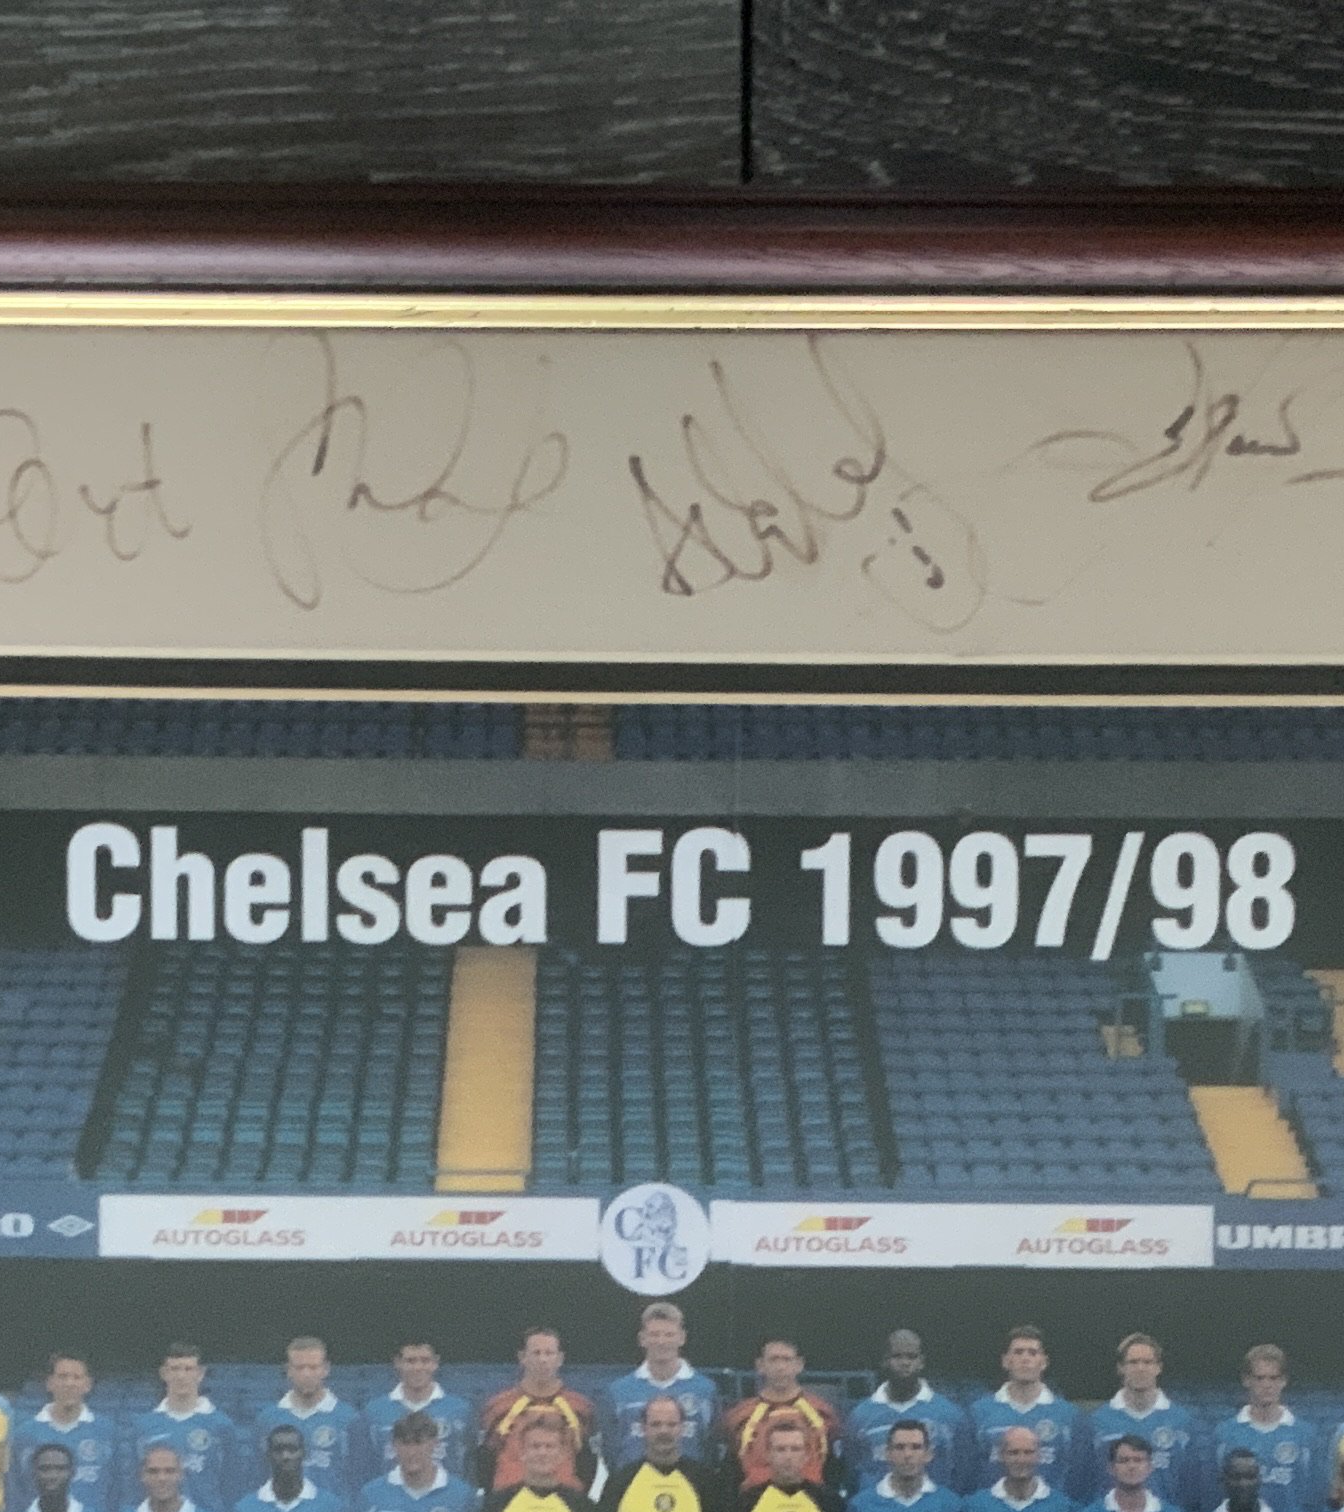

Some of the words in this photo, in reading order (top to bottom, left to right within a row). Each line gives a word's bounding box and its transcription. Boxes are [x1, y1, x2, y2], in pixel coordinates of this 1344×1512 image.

[66, 822, 548, 945] Chelsea
[597, 827, 752, 947] FC
[800, 831, 1296, 961] 1997/98
[153, 1229, 306, 1246] AUTOGLASS
[390, 1230, 544, 1247] AUTOGLASS
[756, 1236, 907, 1253] AUTOGLASS
[1016, 1237, 1169, 1255] AUTOGLASS
